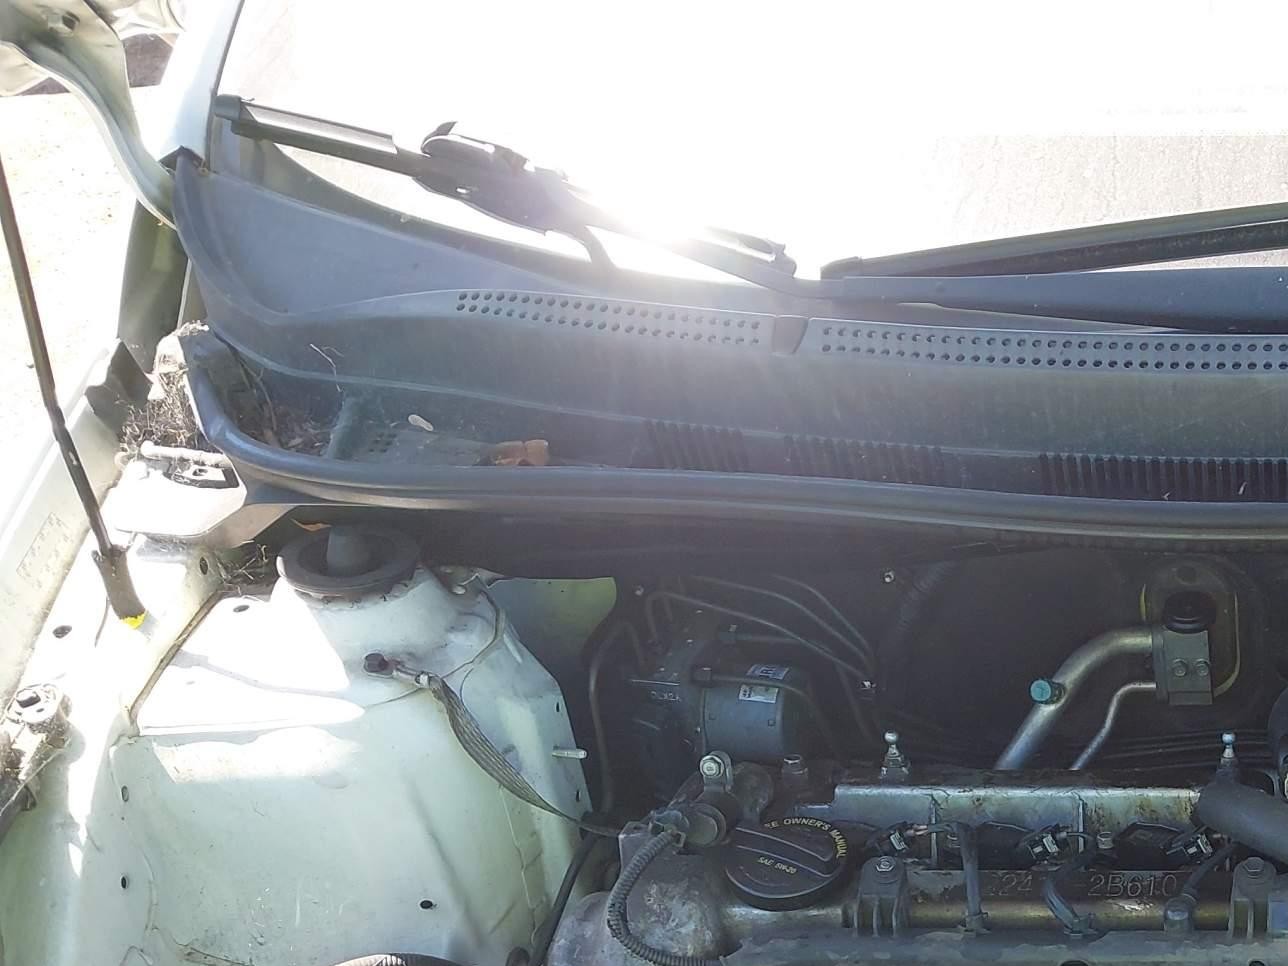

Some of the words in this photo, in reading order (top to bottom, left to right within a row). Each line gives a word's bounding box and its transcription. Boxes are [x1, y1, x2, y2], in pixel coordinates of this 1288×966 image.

[783, 817, 832, 831] OWNER'S
[829, 829, 848, 858] MANUAL
[757, 856, 775, 866] SAE
